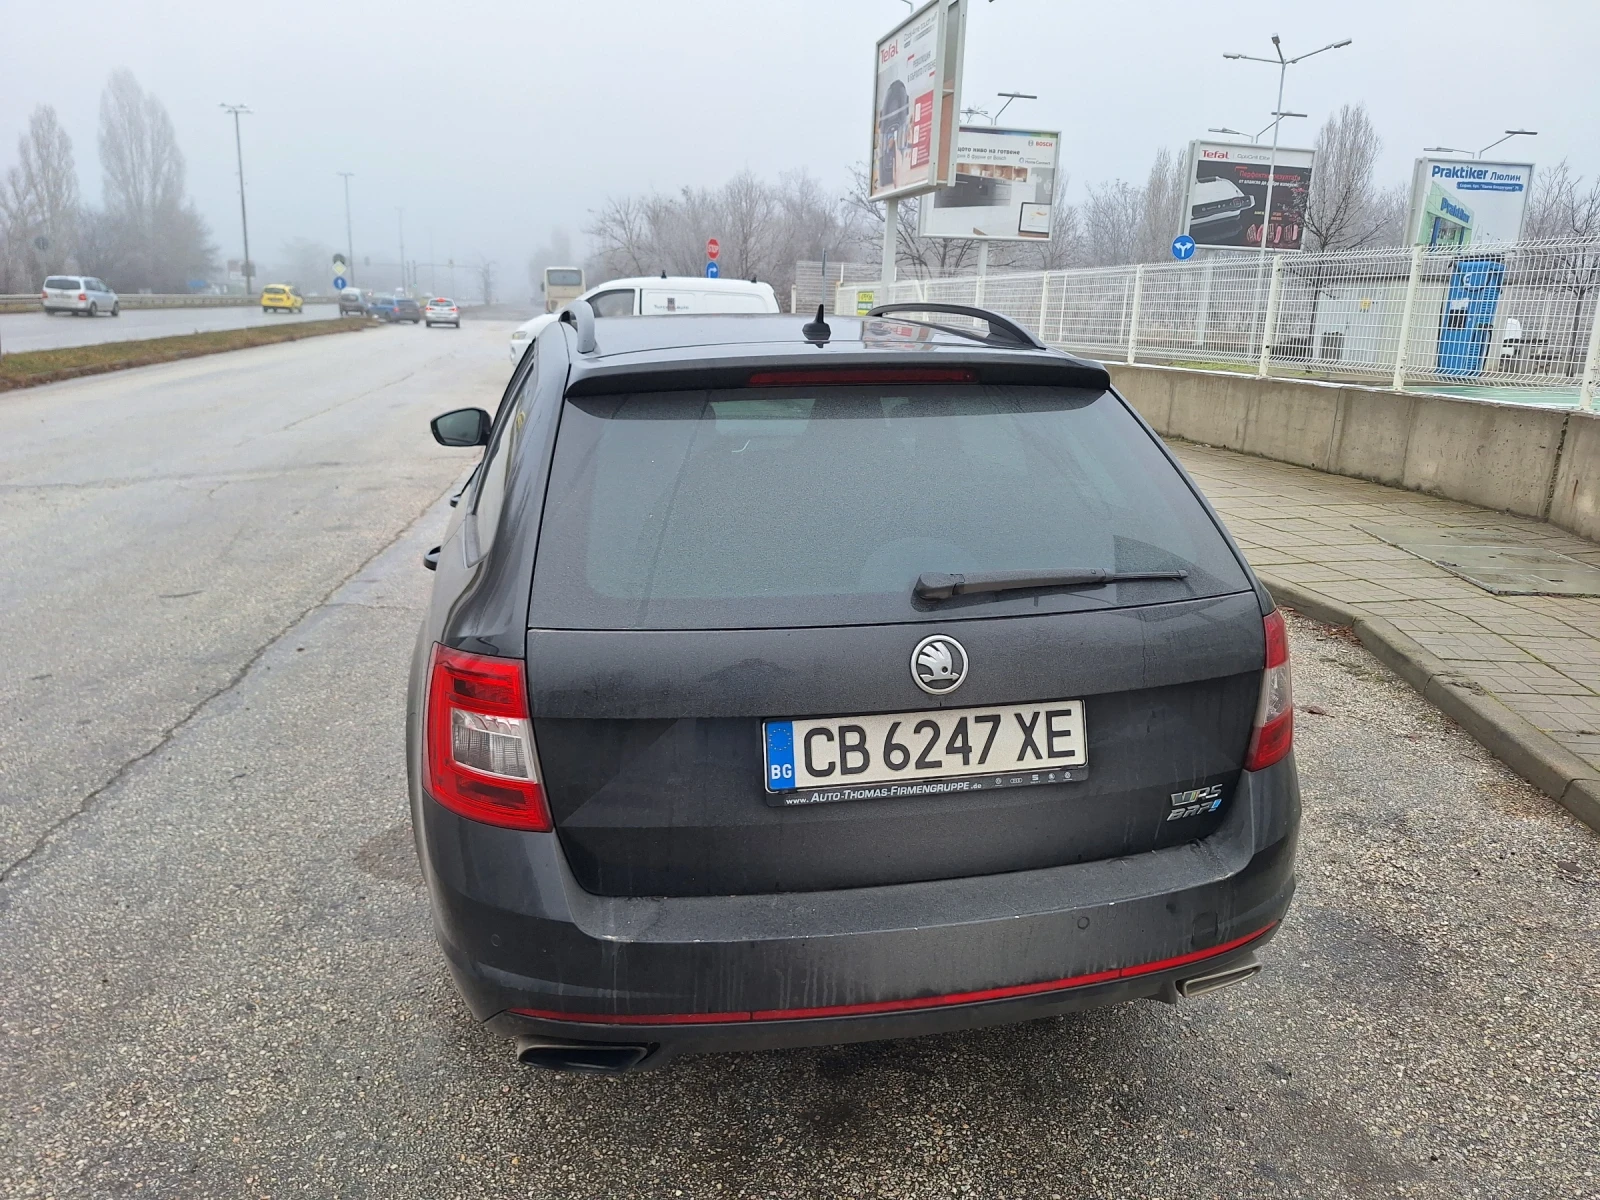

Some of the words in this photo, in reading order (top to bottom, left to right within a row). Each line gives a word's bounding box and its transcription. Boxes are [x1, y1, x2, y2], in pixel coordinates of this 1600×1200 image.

[881, 39, 899, 64] Tefal
[1202, 150, 1229, 160] Tefal
[1432, 165, 1489, 180] Praktiker
[1490, 172, 1521, 182] Люлин
[770, 763, 792, 780] BG
[803, 724, 870, 778] CB
[883, 714, 1001, 772] 6247
[1014, 709, 1075, 762] XE
